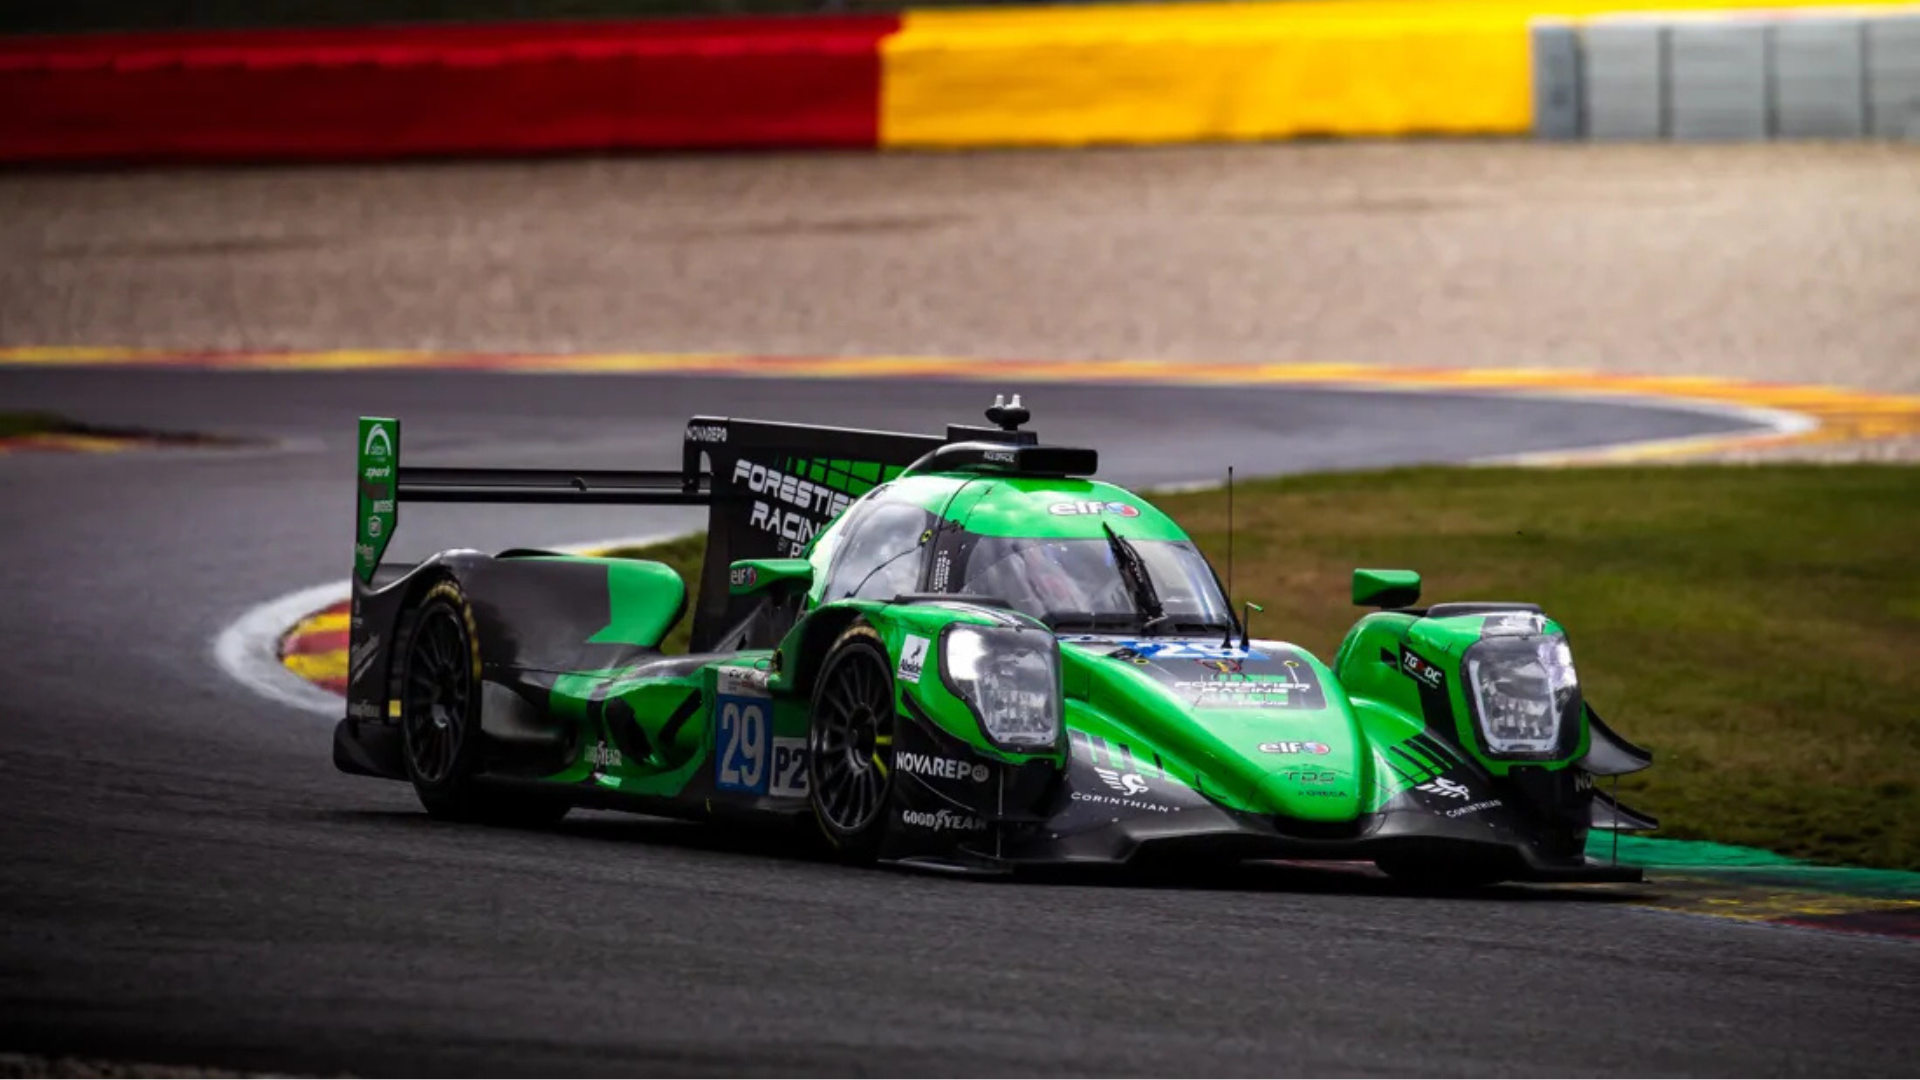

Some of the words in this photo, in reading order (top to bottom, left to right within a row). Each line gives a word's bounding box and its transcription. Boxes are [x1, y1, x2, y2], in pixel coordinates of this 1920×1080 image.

[1050, 501, 1105, 516] elf
[750, 501, 828, 543] RACIN
[730, 569, 746, 585] elf
[721, 703, 765, 787] 29
[1259, 741, 1303, 754] elf
[774, 746, 807, 789] P2
[1071, 791, 1169, 813] CORINTHIAN
